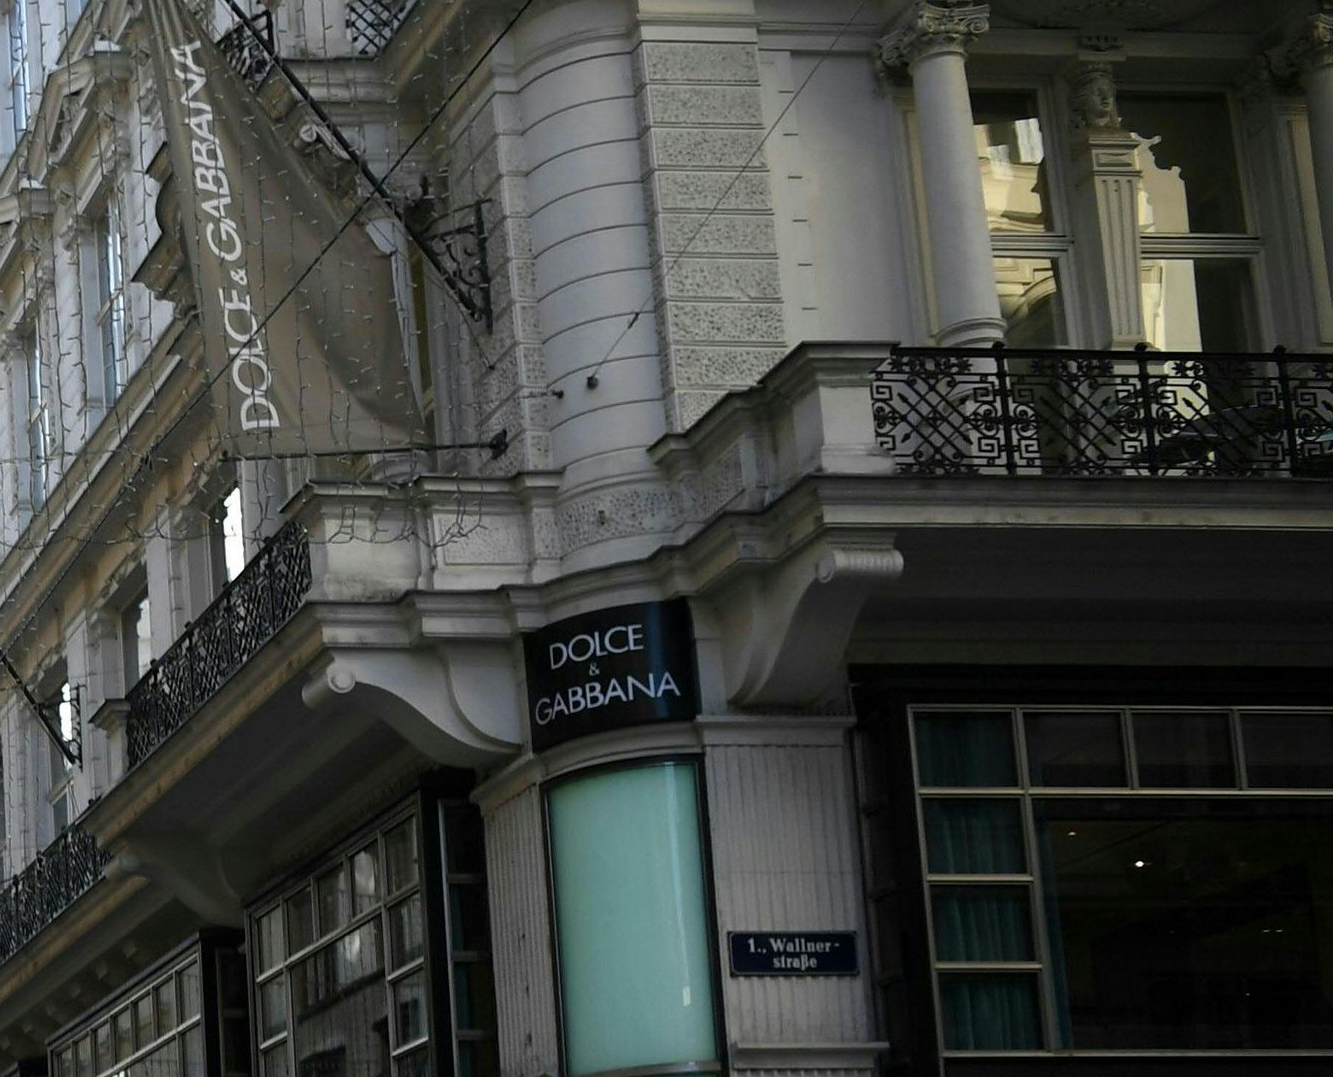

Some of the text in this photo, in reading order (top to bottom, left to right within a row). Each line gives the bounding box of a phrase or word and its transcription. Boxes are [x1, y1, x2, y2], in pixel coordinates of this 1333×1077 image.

[170, 40, 281, 431] DOLCE & GABBANA
[549, 624, 644, 670] DOLCE
[589, 663, 600, 676] &
[535, 671, 681, 725] GABBANA
[772, 954, 818, 971] straße
